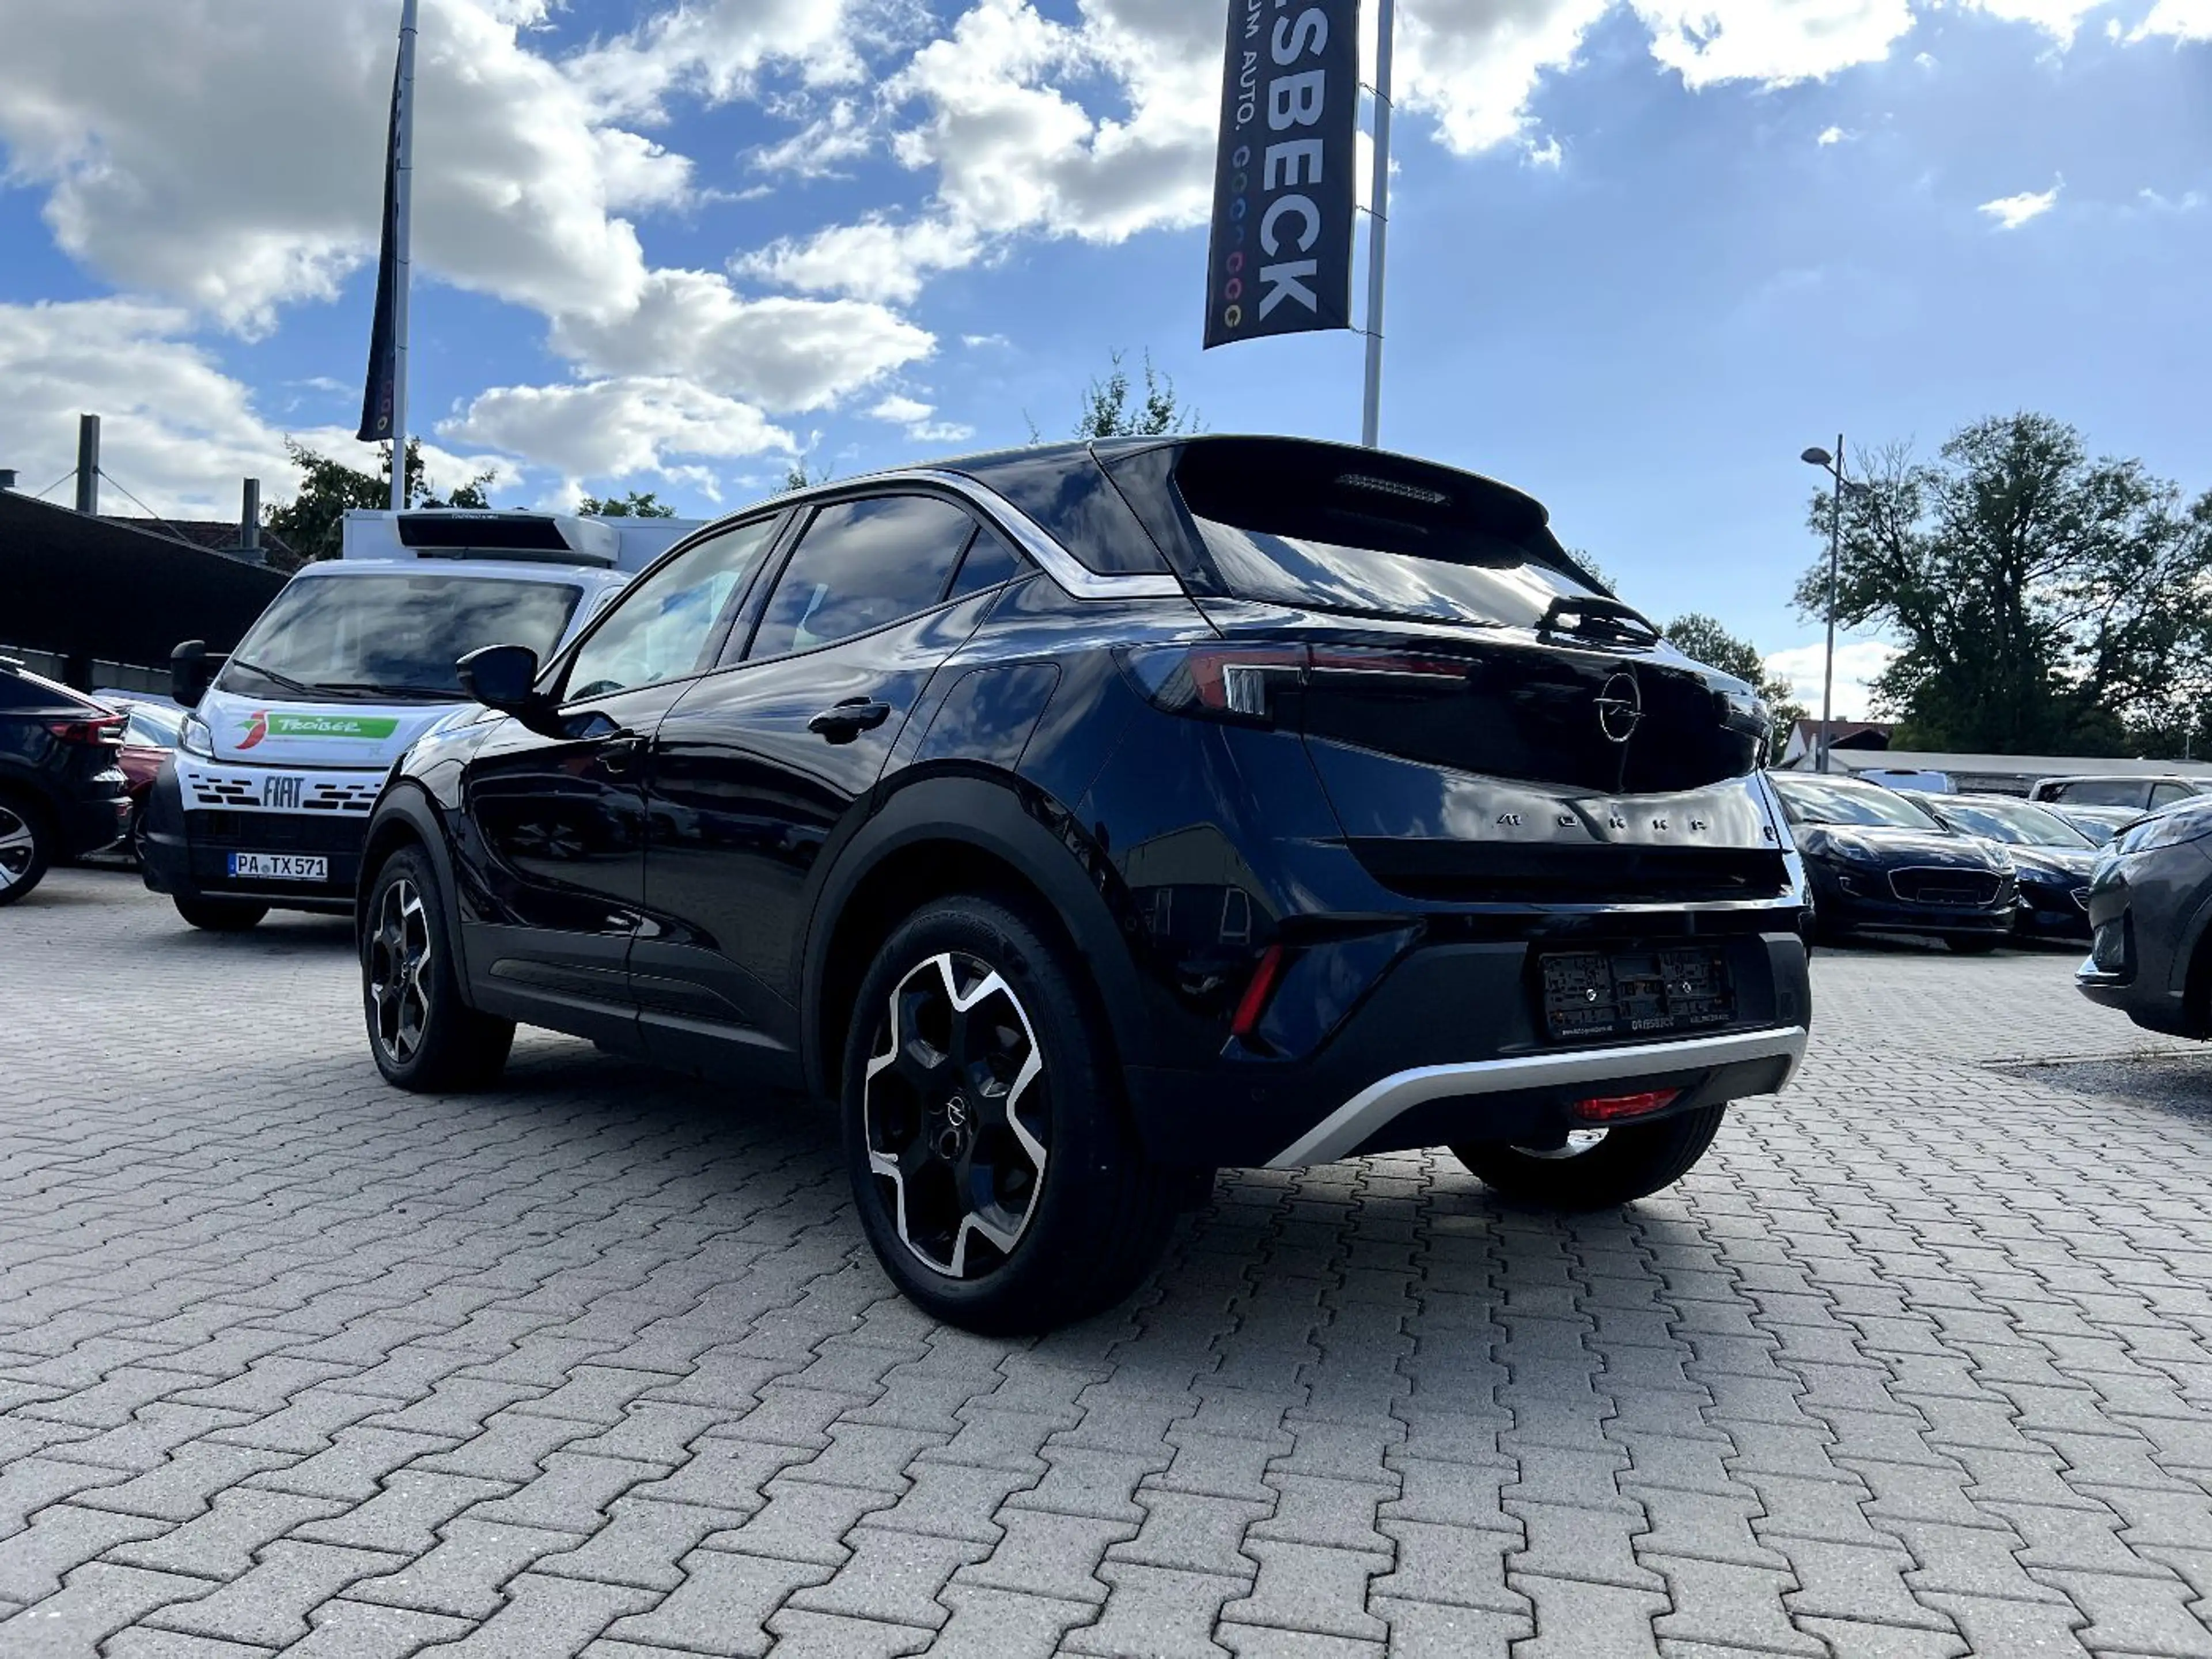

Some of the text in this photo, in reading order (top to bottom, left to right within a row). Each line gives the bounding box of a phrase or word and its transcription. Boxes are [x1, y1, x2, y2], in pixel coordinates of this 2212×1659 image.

[1259, 0, 1328, 321] SBECK
[263, 776, 305, 808] FIAT
[238, 855, 258, 873] PA
[270, 857, 291, 874] TX
[295, 858, 325, 876] 571
